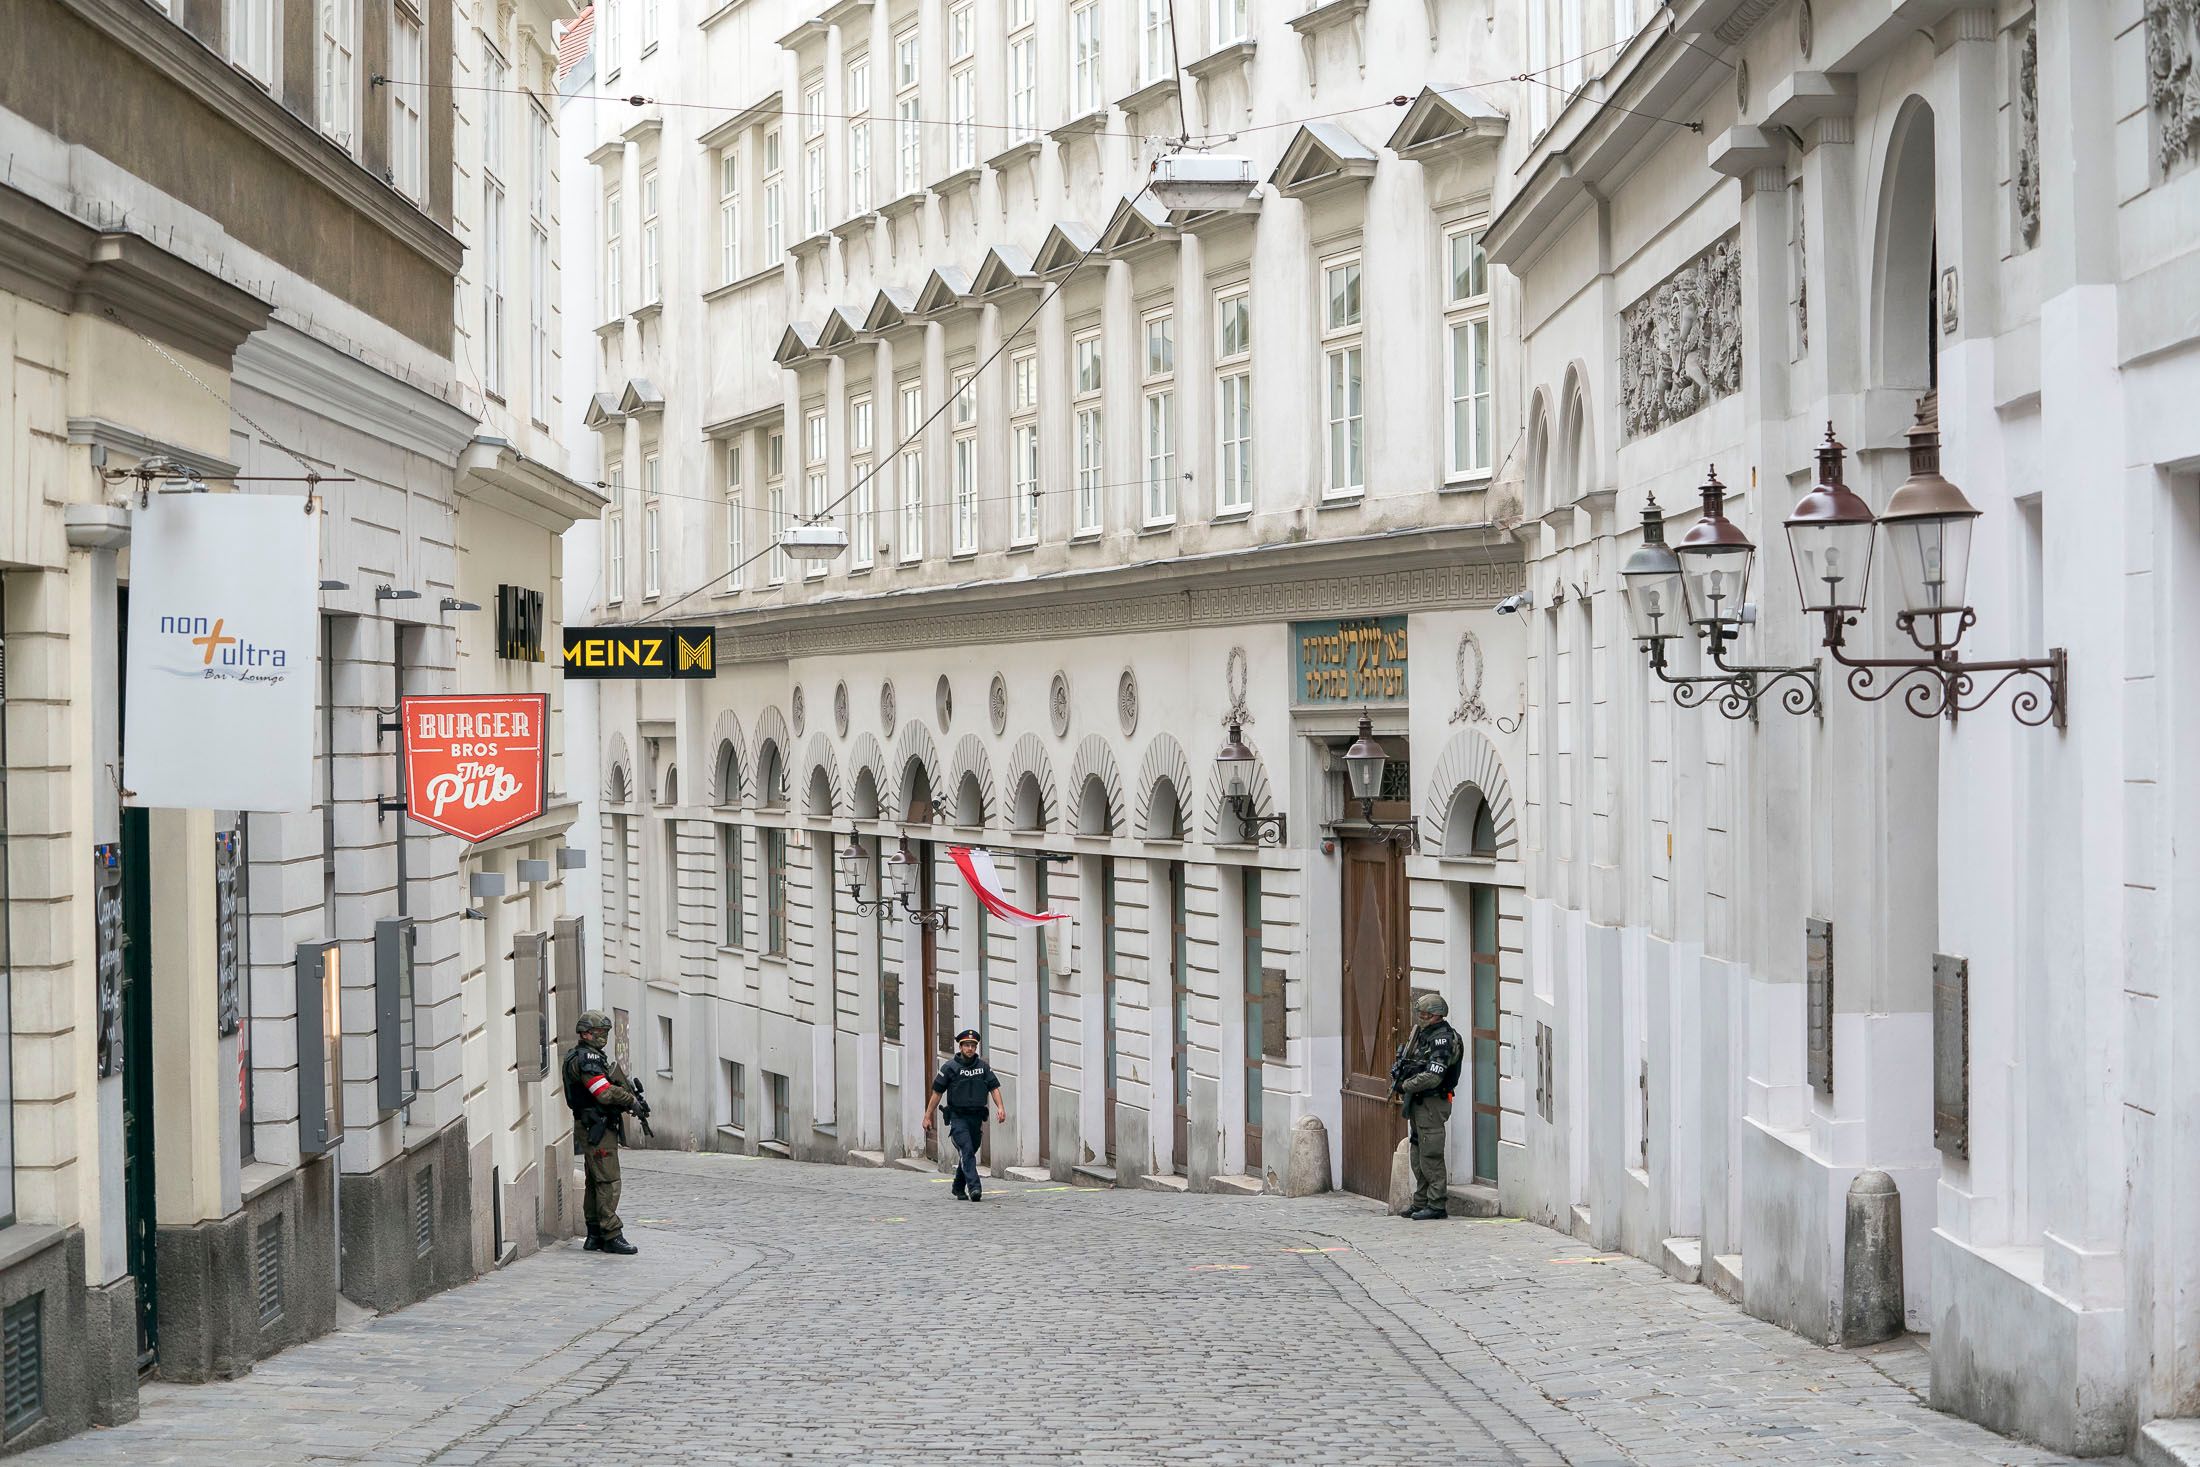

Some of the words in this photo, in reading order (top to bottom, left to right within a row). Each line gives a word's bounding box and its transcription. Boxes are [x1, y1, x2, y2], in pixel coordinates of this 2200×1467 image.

[161, 616, 207, 634] non
[223, 639, 285, 666] ultra
[204, 668, 227, 680] Bar
[238, 668, 285, 686] Lounge
[418, 712, 530, 739] BURGER
[451, 742, 498, 757] BROS
[456, 761, 497, 782] The
[426, 767, 523, 817] Pub
[960, 1068, 984, 1076] POLIZEI
[1430, 1064, 1444, 1074] MP
